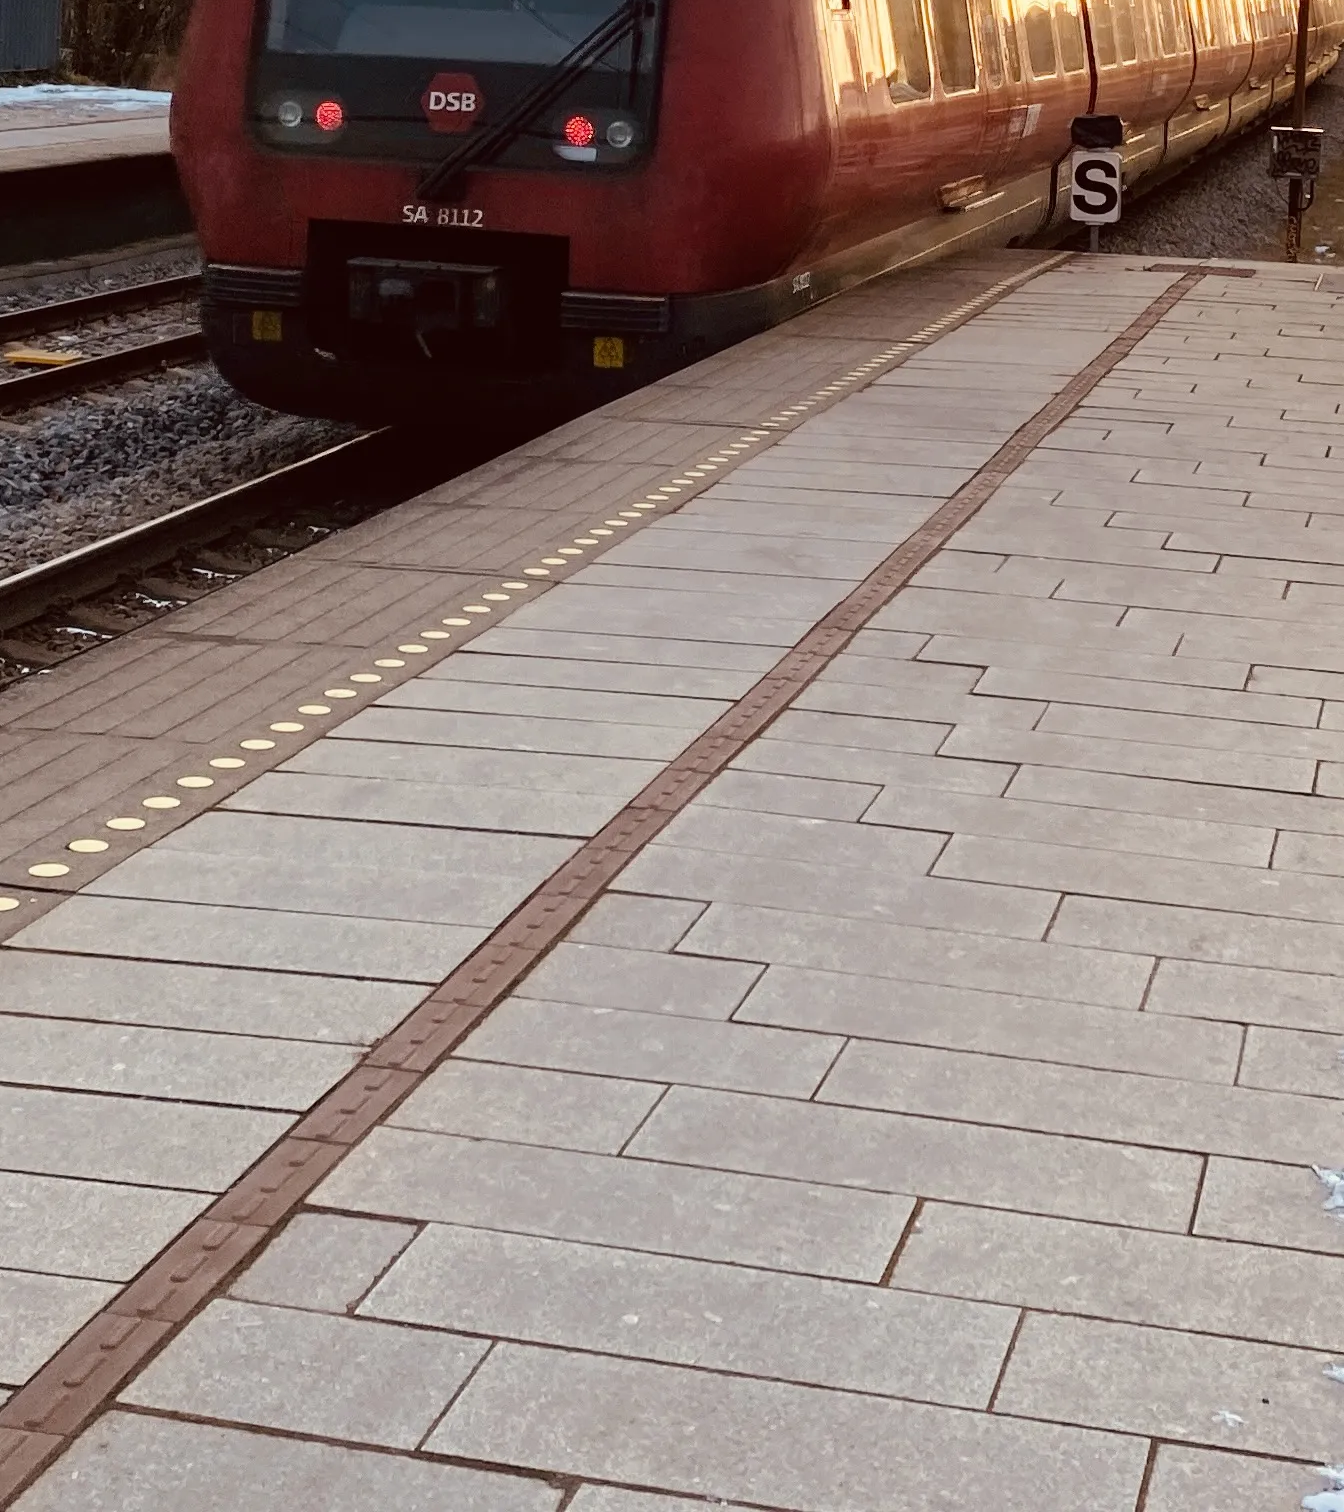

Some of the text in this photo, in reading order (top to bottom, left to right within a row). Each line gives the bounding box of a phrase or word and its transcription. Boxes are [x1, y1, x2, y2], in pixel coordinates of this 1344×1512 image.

[428, 90, 477, 113] DSB
[1072, 159, 1118, 215] S
[402, 204, 484, 228] SA 8112
